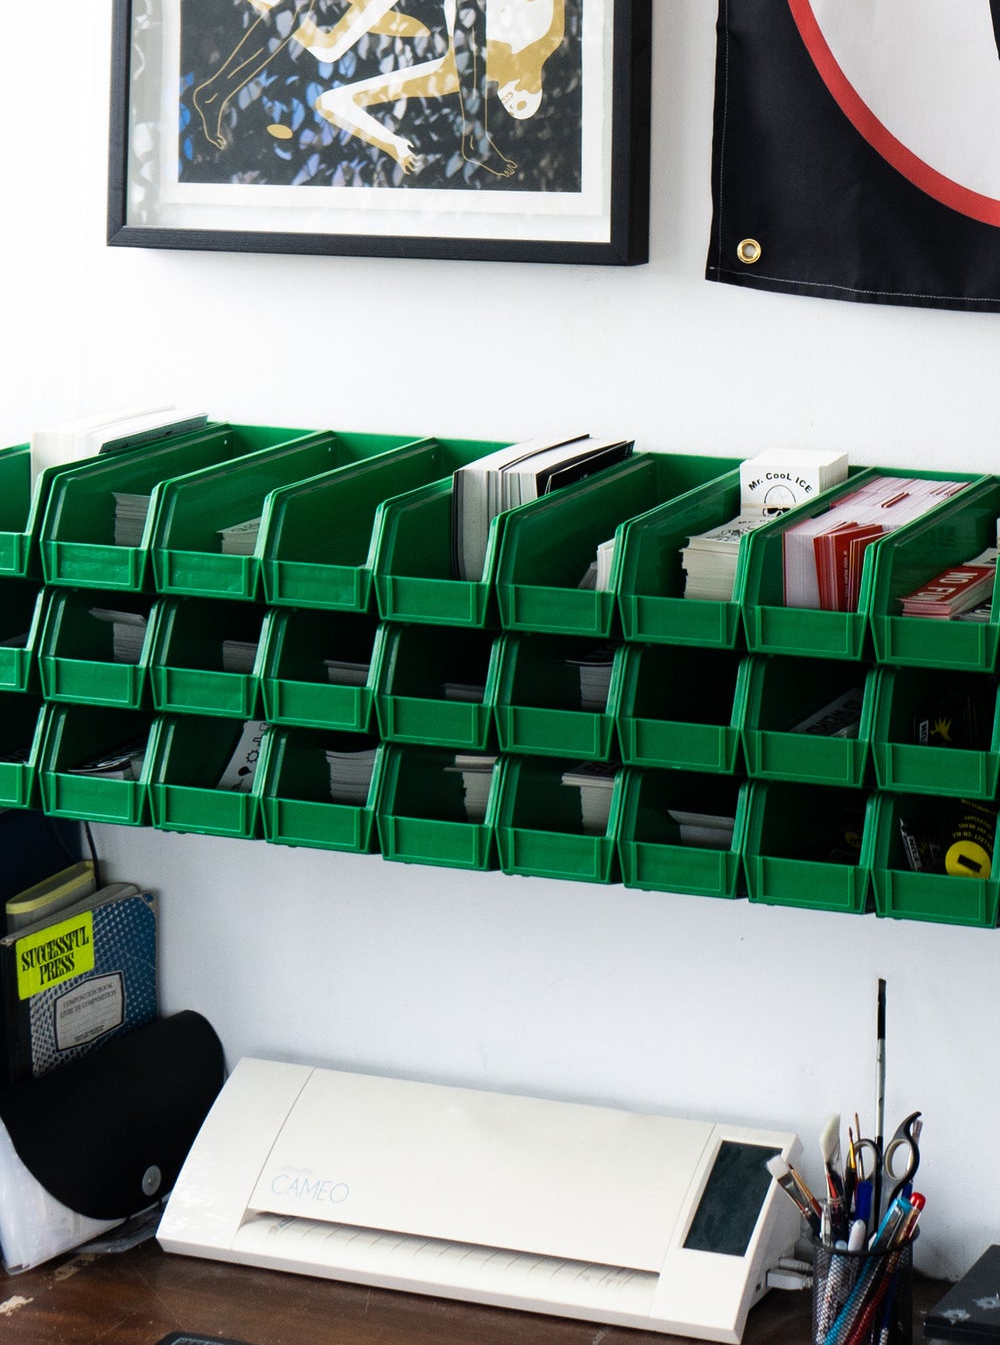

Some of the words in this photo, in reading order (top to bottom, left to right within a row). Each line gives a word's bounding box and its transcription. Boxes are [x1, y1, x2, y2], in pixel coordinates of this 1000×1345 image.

[748, 477, 764, 492] Mr.
[795, 476, 813, 494] ICE
[938, 571, 979, 584] NO
[21, 925, 90, 972] SUCCESSFUL
[39, 952, 75, 986] PRESS
[271, 1174, 350, 1204] CAMEO
